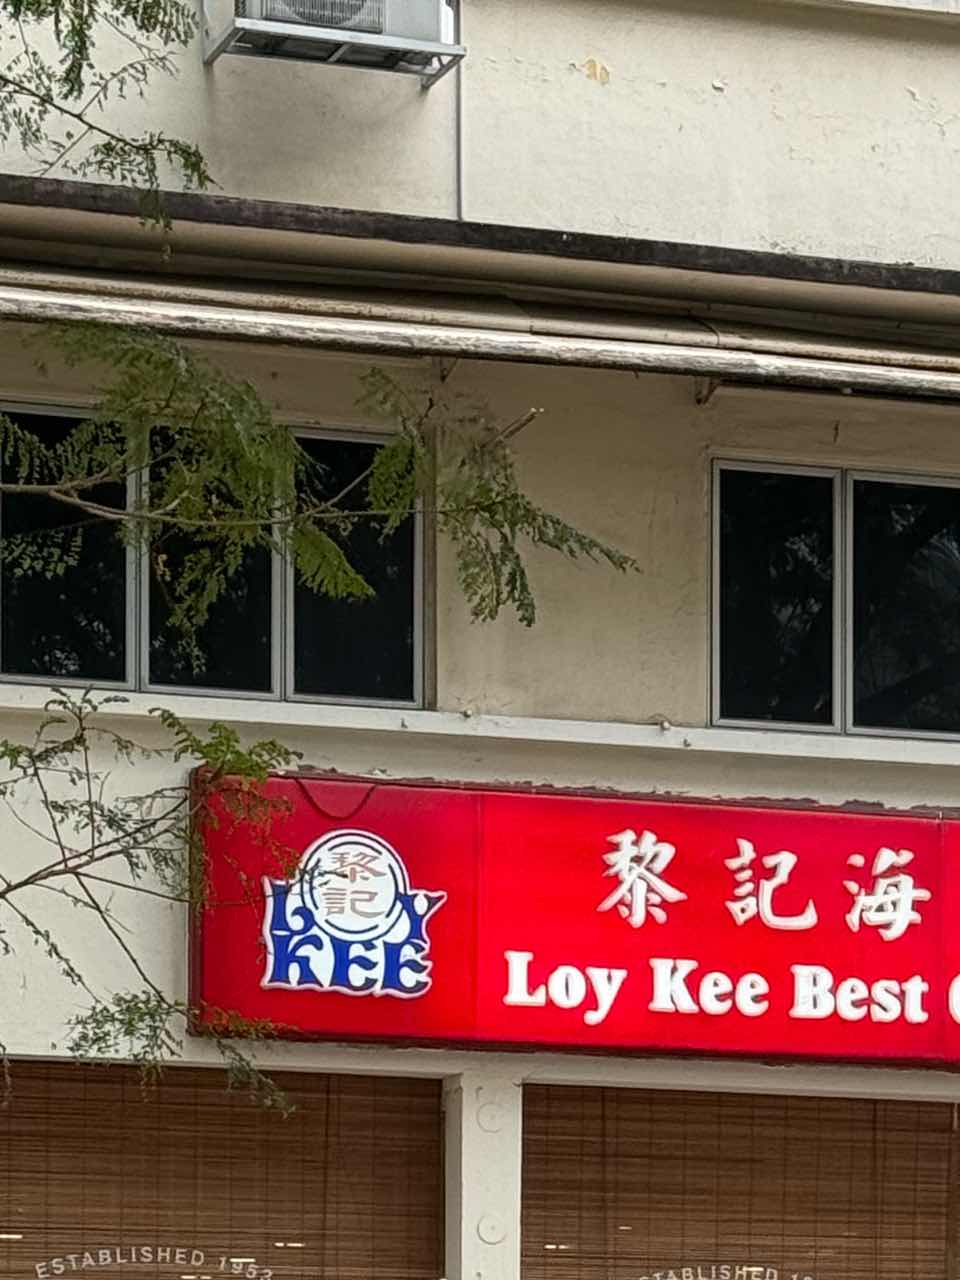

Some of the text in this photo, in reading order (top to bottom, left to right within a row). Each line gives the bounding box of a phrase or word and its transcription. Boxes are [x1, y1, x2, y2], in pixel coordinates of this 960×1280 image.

[267, 933, 431, 994] KEE
[503, 950, 627, 1026] Loy
[648, 957, 770, 1017] Kee
[789, 964, 929, 1024] Best
[36, 1247, 205, 1279] ESTABLISHED
